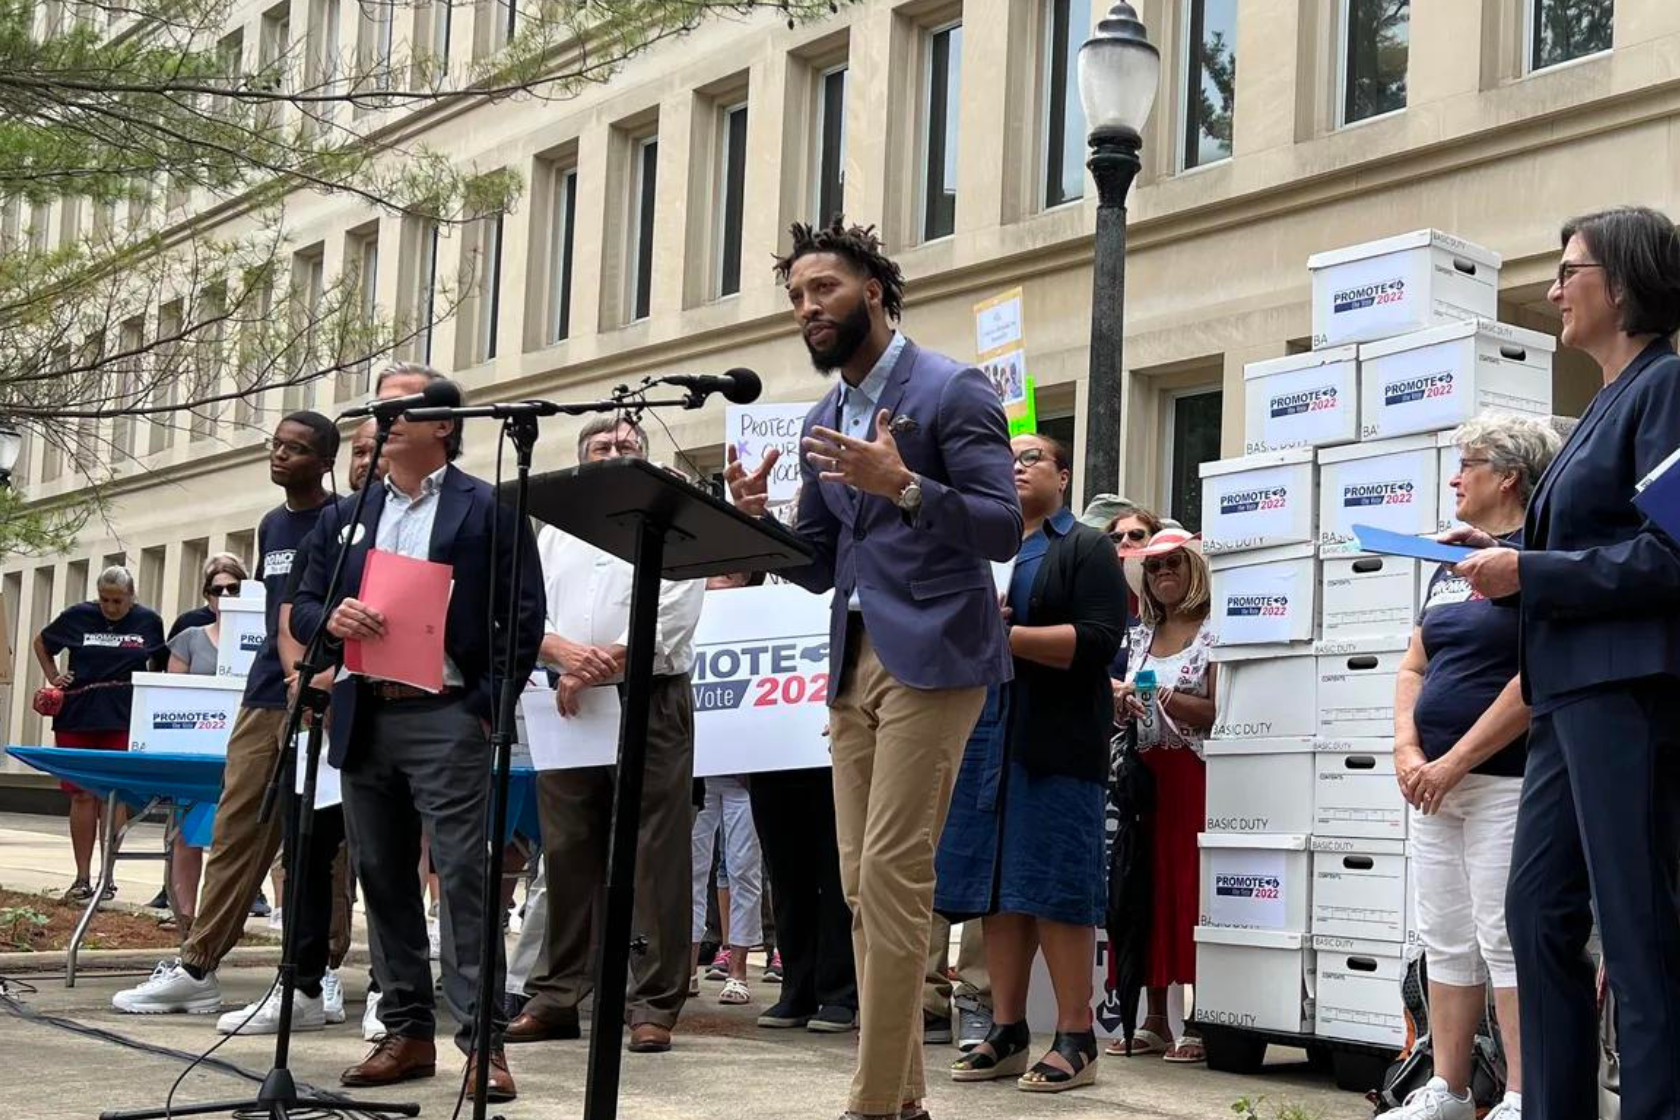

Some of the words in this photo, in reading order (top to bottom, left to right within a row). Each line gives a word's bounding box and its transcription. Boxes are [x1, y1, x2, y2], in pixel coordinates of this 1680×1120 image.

[1334, 282, 1389, 303] PROMOTE
[1376, 291, 1404, 305] 2022
[1385, 375, 1438, 395] PROMOTE
[1426, 384, 1454, 398] 2022
[1270, 391, 1322, 408] PROMOTE
[1310, 398, 1337, 411] 2022
[741, 414, 807, 437] PROTECT
[1344, 483, 1397, 497] PROMOTE
[1220, 490, 1271, 506] PROMOTE
[1260, 498, 1286, 510] 2022
[1386, 493, 1413, 505] 2022
[1227, 596, 1273, 607] PROMOTE
[1262, 606, 1287, 616] 2022
[240, 634, 265, 645] PRO
[690, 643, 798, 681] MOTE
[693, 686, 734, 709] Vote
[753, 672, 829, 707] 202
[153, 712, 210, 722] PROMOTE
[198, 721, 226, 730] 2022
[1213, 724, 1243, 736] BASIC
[1244, 722, 1273, 735] DUTY
[1208, 818, 1239, 830] BASIC
[1240, 818, 1268, 830] DUTY
[1312, 840, 1333, 850] BASIC
[1334, 841, 1354, 851] DUTY
[1216, 876, 1266, 888] PROMOTE
[1254, 888, 1279, 899] 2022
[1315, 937, 1334, 947] BASIC
[1335, 938, 1354, 949] DUTY
[1197, 1009, 1227, 1023] BASIC
[1228, 1011, 1257, 1027] DUTY
